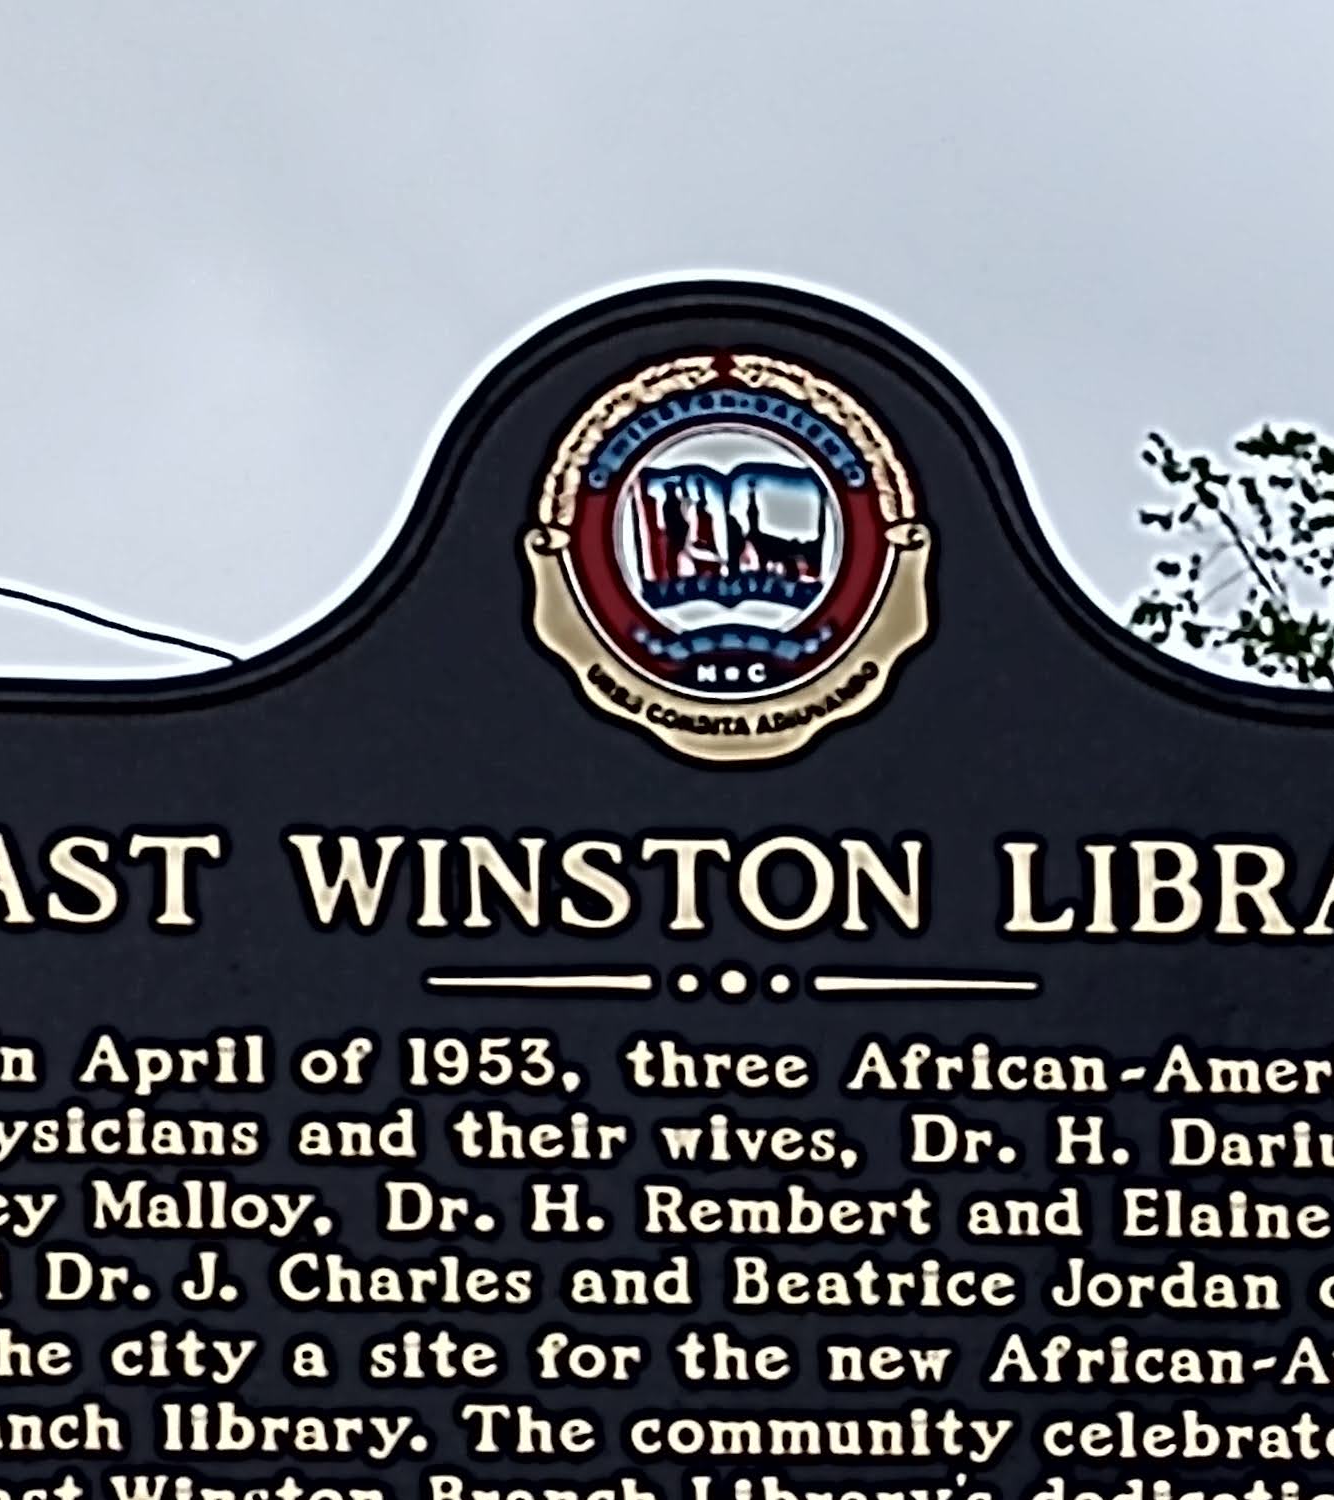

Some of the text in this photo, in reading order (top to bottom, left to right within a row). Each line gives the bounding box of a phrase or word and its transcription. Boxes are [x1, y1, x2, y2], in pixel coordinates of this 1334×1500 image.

[287, 833, 923, 932] WINSTON
[78, 1033, 266, 1097] April
[299, 1036, 374, 1085] of
[407, 1036, 582, 1093] 1953,
[624, 1038, 810, 1090] three
[297, 1107, 418, 1159] and
[452, 1109, 627, 1161] their
[659, 1113, 859, 1170] wives,
[910, 1112, 1017, 1165] Dr.
[1055, 1114, 1131, 1166] H.
[91, 1178, 334, 1238] Malloy,
[384, 1180, 496, 1233] Dr.
[530, 1182, 606, 1233] H.
[643, 1183, 932, 1237] Rembert
[967, 1186, 1084, 1237] and
[1122, 1187, 1332, 1241] Elaine
[44, 1250, 152, 1303] Dr.
[180, 1250, 239, 1303] J.
[278, 1251, 533, 1305] Charles
[570, 1254, 693, 1306] and
[732, 1255, 1017, 1308] Beatrice
[1050, 1256, 1282, 1311] Jordan
[110, 1329, 257, 1385] city
[292, 1341, 330, 1379] a
[369, 1329, 499, 1379] site
[535, 1331, 642, 1381] for
[675, 1331, 791, 1382] the
[826, 1344, 953, 1383] new
[161, 1400, 429, 1461] library.
[460, 1403, 596, 1454] The
[629, 1407, 1014, 1464] community
